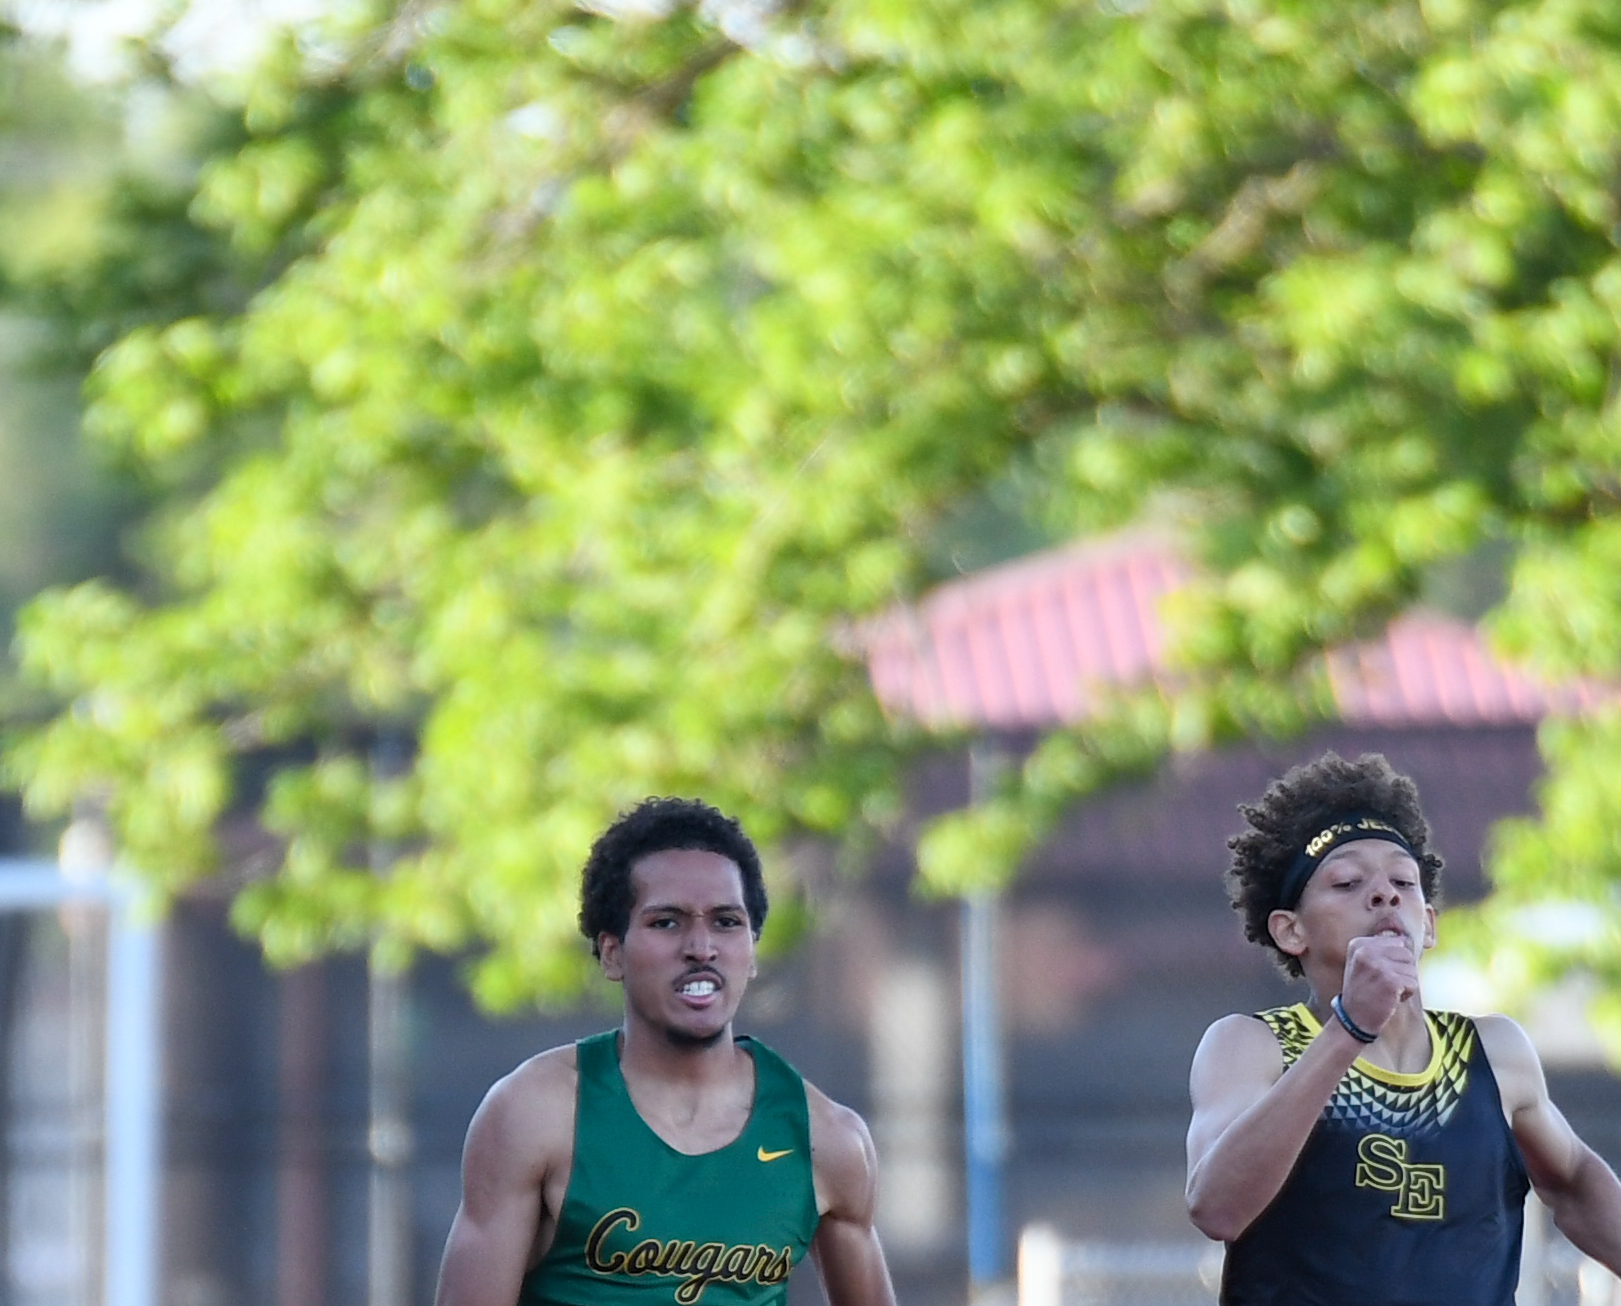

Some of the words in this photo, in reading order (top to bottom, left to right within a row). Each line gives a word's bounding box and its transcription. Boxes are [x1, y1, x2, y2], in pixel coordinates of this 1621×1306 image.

[1304, 822, 1352, 857] 100%
[1355, 1133, 1444, 1219] SE
[584, 1206, 792, 1306] Cougars
